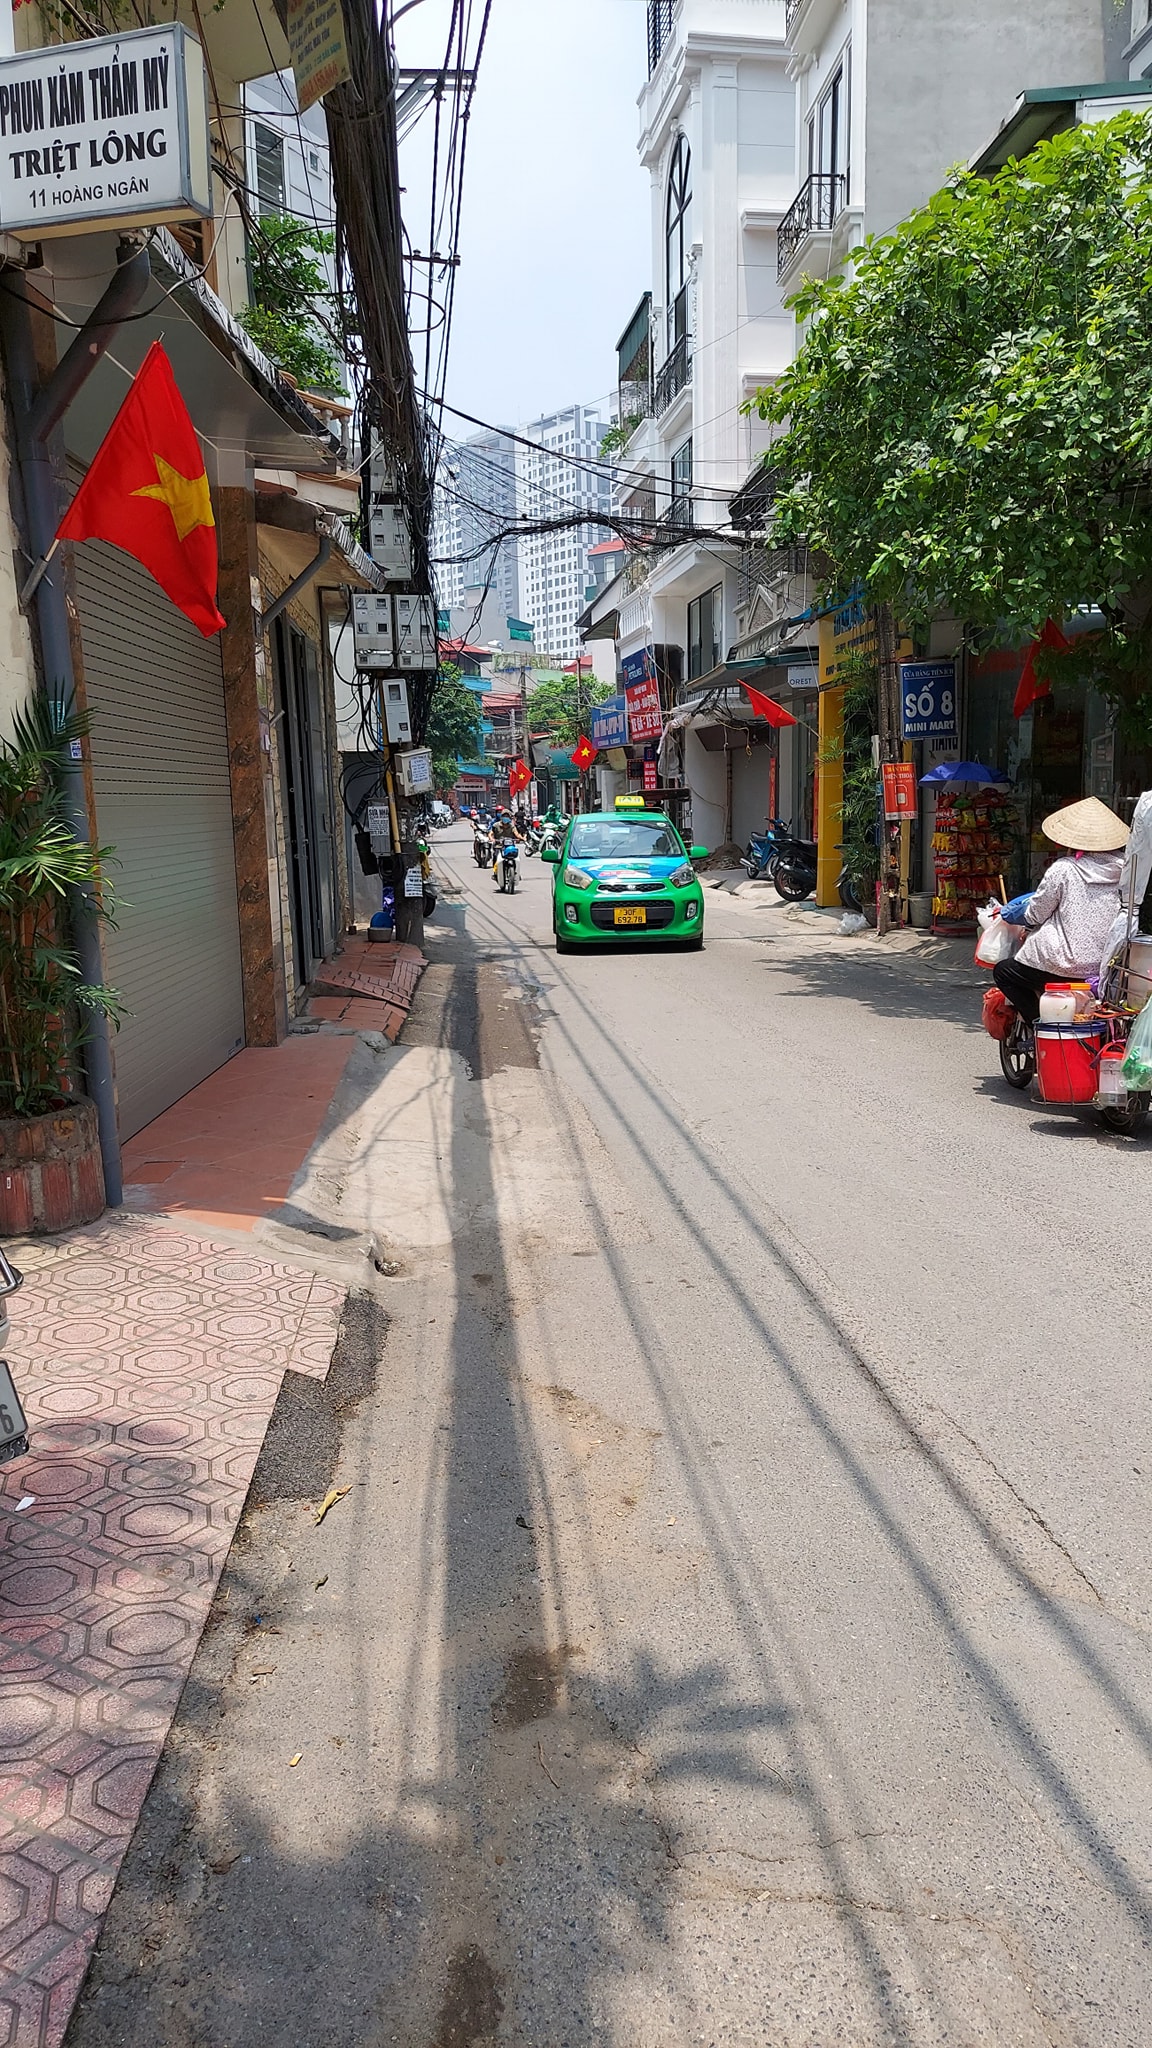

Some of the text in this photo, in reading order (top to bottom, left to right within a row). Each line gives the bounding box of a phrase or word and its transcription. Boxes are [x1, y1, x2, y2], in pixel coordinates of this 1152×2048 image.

[0, 44, 169, 137] PHUN XĂM THẨM MỸ
[9, 129, 167, 179] TRIỆT LÔNG
[29, 176, 149, 208] 11 HOÀNG NGÂN
[906, 681, 953, 718] SỐ 8
[905, 720, 954, 732] MINI MART
